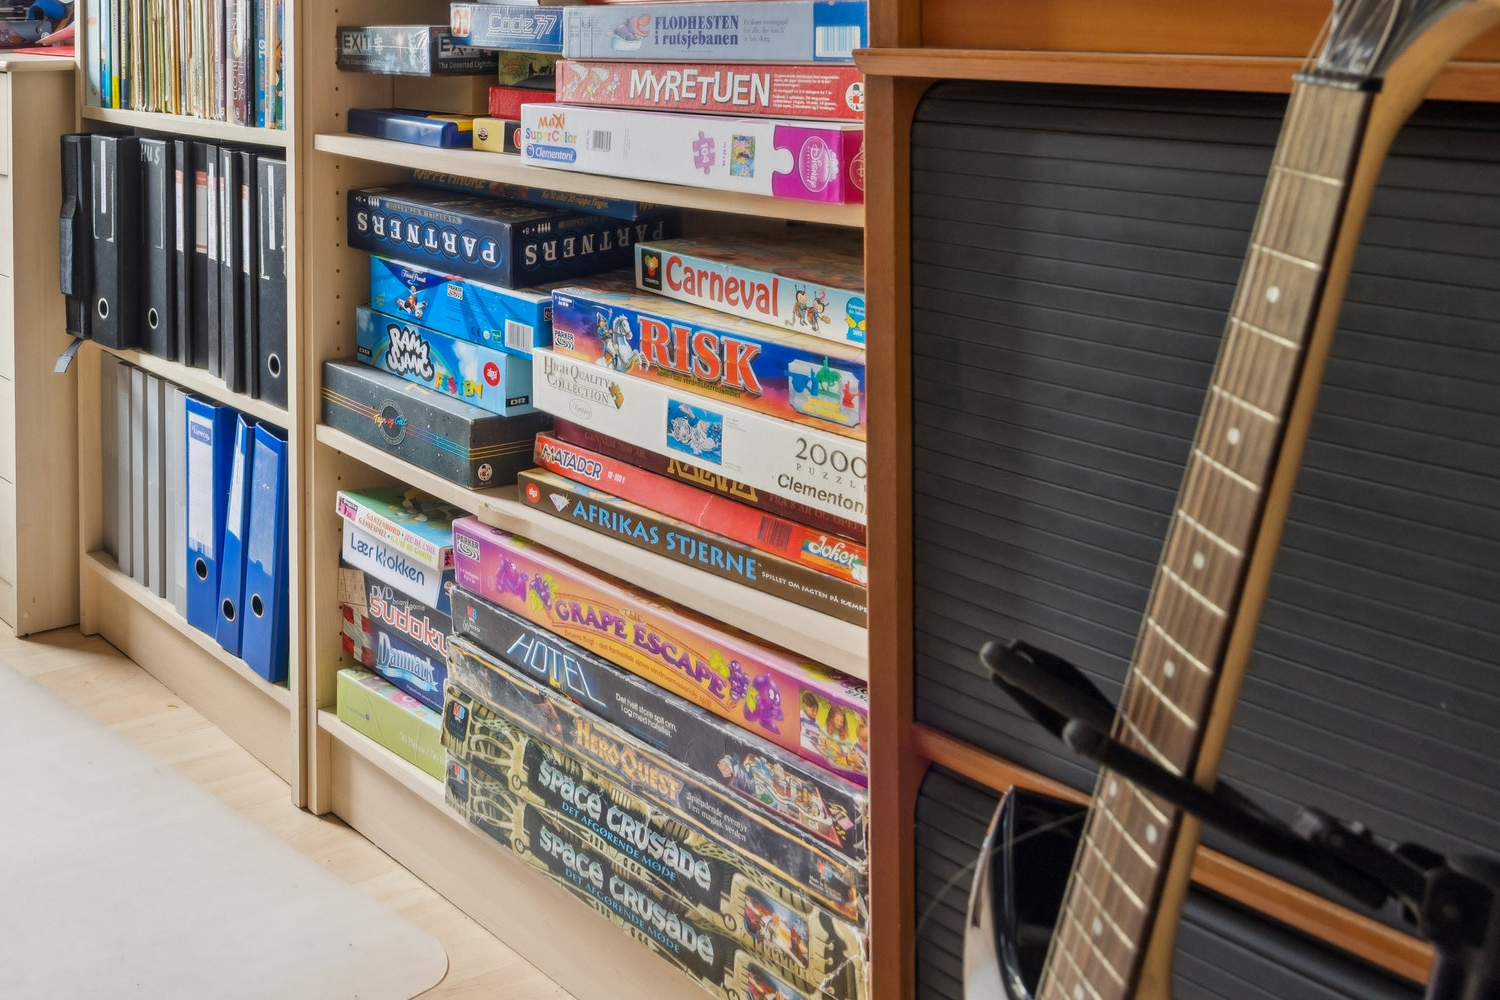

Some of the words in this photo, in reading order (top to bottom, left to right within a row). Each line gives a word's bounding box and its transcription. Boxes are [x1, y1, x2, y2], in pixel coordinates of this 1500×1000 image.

[489, 13, 534, 35] Code
[654, 15, 740, 31] FLODHESTEN
[343, 34, 370, 53] EXIT
[654, 31, 659, 45] i
[661, 31, 740, 50] rutsjebanen
[438, 61, 448, 69] The
[449, 61, 473, 69] Deserted
[629, 69, 771, 107] MYRETUEN
[525, 127, 578, 146] SuperColor
[535, 146, 575, 161] Clementoni
[699, 142, 710, 165] 104
[357, 211, 497, 264] PARTNERS
[523, 220, 664, 267] PARTNERS
[665, 255, 780, 318] Carneval
[358, 347, 370, 356] DR
[389, 326, 429, 360] RAMA
[554, 329, 574, 343] PARKER
[543, 354, 568, 378] HIGH
[570, 367, 611, 388] QUALITY
[637, 315, 764, 397] RISK
[434, 371, 484, 399] FESTEN
[510, 397, 526, 406] DR
[546, 371, 610, 406] COLLECTION
[540, 444, 603, 481] MATADOR
[795, 437, 867, 480] 2000
[366, 512, 401, 538] GANZENBORD
[456, 533, 479, 551] PARKER
[572, 500, 660, 545] AFRIKAS
[665, 531, 758, 581] STJERNE
[350, 532, 374, 559] Lær
[375, 545, 425, 587] klokken
[413, 547, 433, 564] GOOSE
[807, 534, 859, 569] Joker
[371, 585, 394, 600] DVD
[761, 570, 787, 587] SPILLET
[787, 580, 801, 590] OM
[801, 585, 828, 599] JAGTEN
[829, 594, 839, 604] PÅ
[466, 604, 478, 620] MB
[377, 631, 435, 683] Danmark
[554, 599, 628, 640] GRAPE
[632, 624, 728, 701] ESCAPE
[506, 633, 607, 708] HOTEL
[452, 704, 467, 720] MB
[615, 692, 627, 705] Det
[627, 698, 639, 711] helt
[638, 704, 653, 718] store
[653, 710, 664, 724] spil
[624, 708, 633, 719] og
[632, 710, 648, 725] med
[453, 763, 466, 782] MB
[538, 760, 602, 822] SPACE
[606, 804, 712, 892] CRUSADE
[685, 790, 723, 817] Spændende
[723, 809, 749, 833] eventyr
[692, 805, 701, 815] en
[701, 810, 724, 829] magisk
[724, 822, 747, 842] verden
[561, 801, 580, 819] DET
[580, 815, 640, 859] AFGØRENDE
[641, 852, 678, 883] MØDE
[539, 825, 604, 890] SPACE
[609, 872, 715, 967] CRUSADE
[564, 868, 583, 886] DET
[584, 882, 646, 929] AFGØRENDE
[646, 926, 681, 955] MØDE
